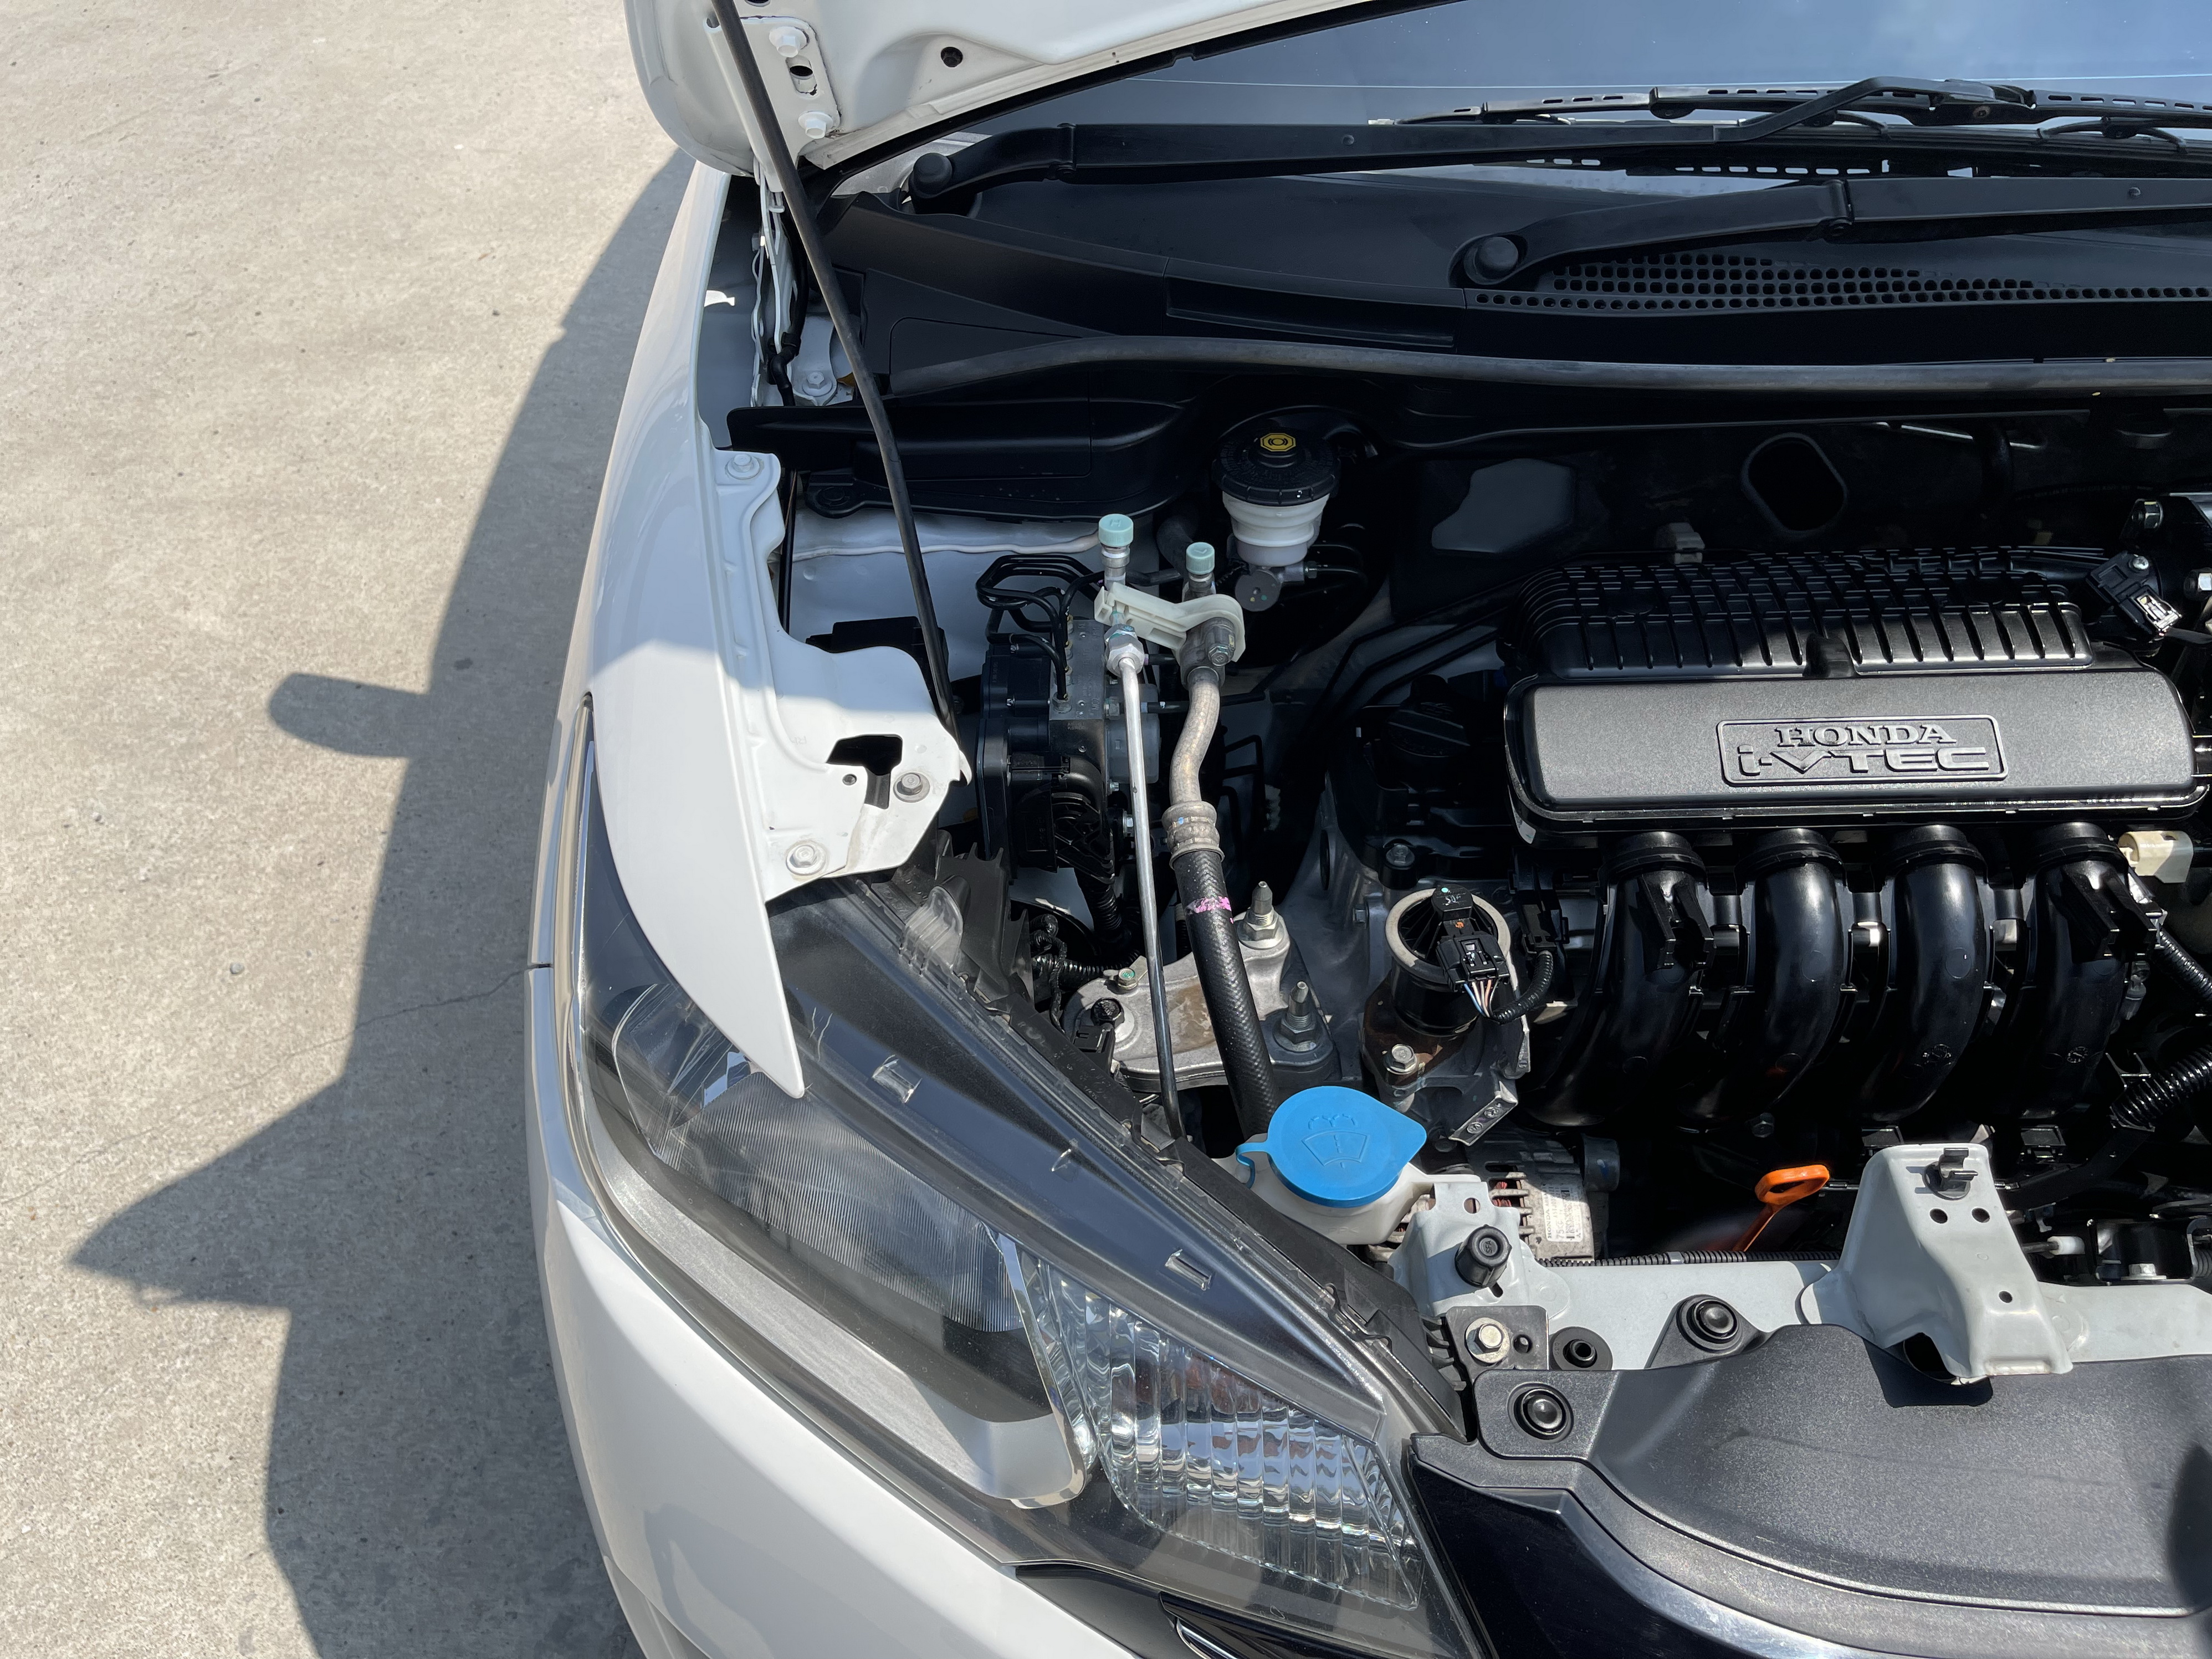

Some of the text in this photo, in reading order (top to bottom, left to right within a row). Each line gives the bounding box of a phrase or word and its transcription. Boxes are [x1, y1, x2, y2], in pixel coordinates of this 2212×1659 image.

[1109, 519, 1122, 527] H
[1773, 724, 1957, 748] HONDA
[1737, 744, 1990, 776] i-VTEC
